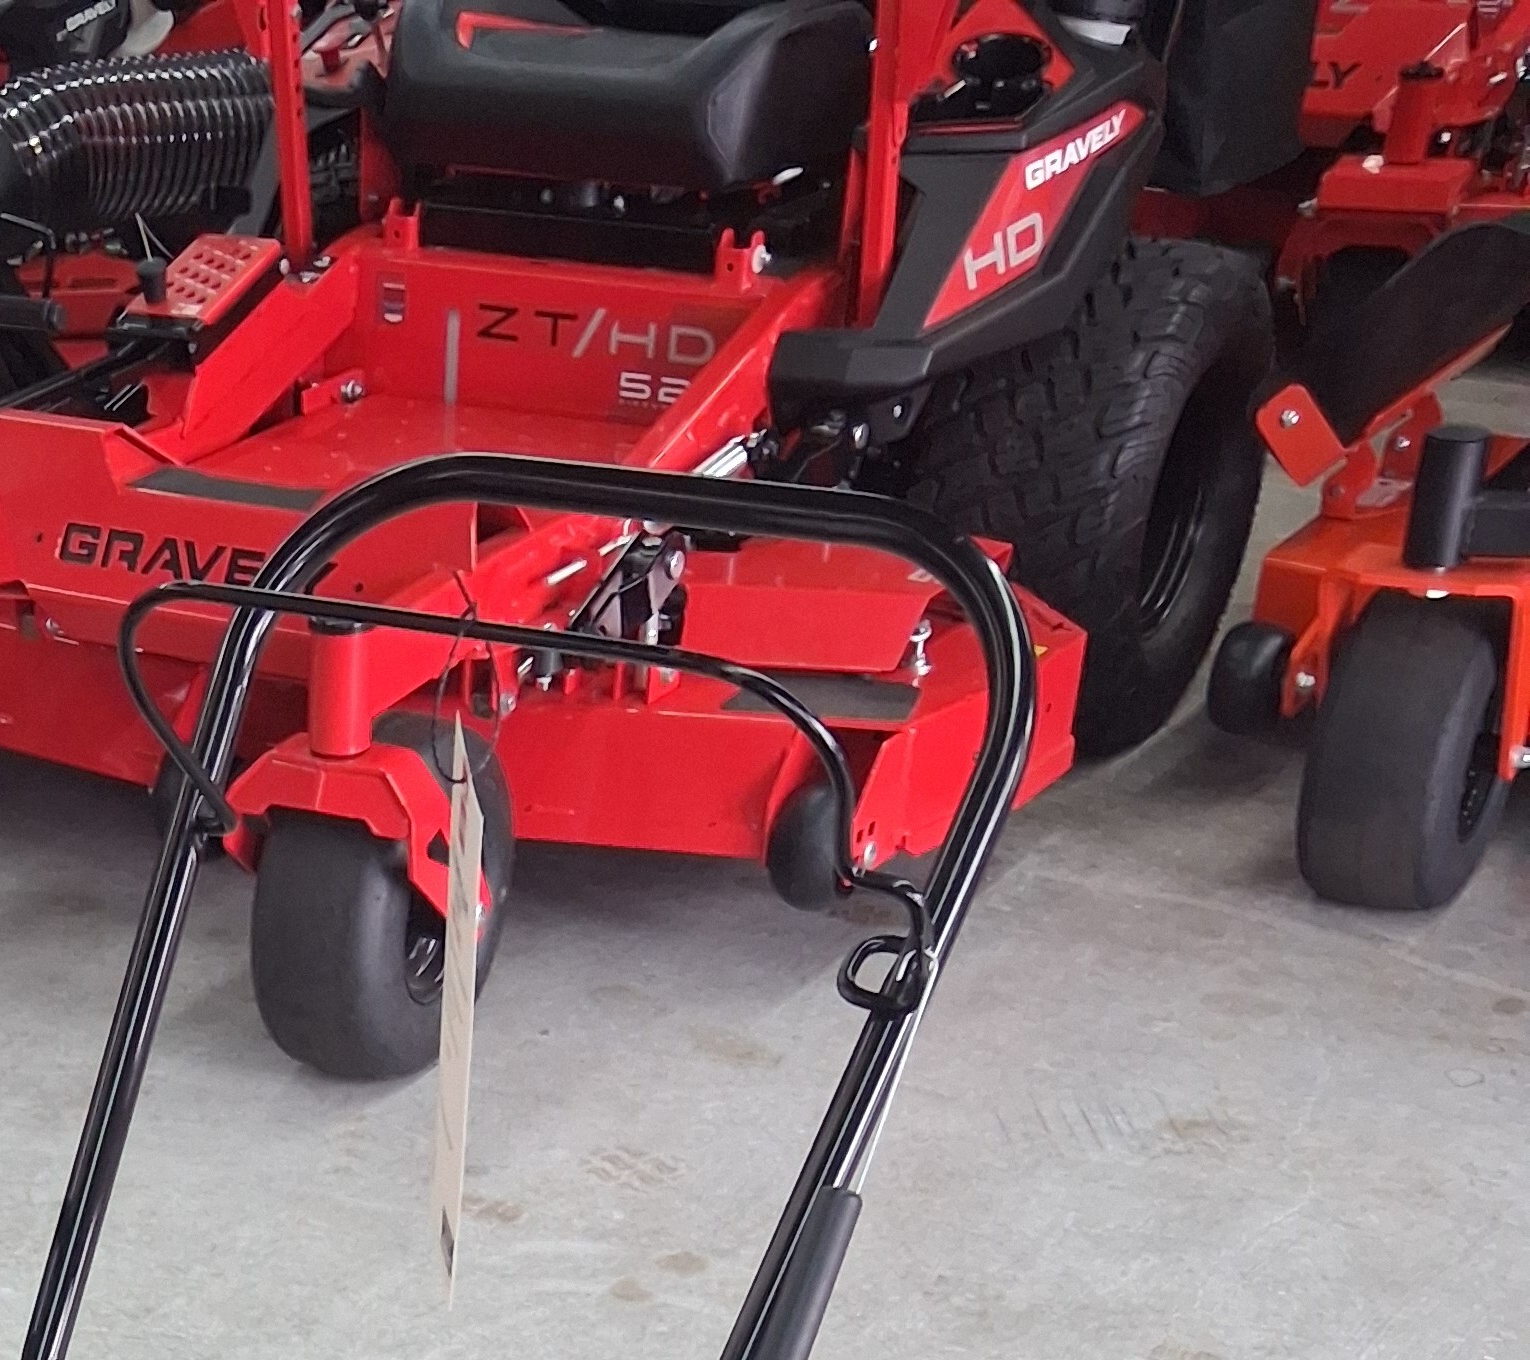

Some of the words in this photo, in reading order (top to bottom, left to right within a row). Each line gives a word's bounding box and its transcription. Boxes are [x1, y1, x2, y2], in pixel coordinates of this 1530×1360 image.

[1025, 109, 1126, 190] GRAVELY
[964, 212, 1045, 290] HD
[619, 371, 692, 404] 52
[60, 522, 338, 596] GRAVEY
